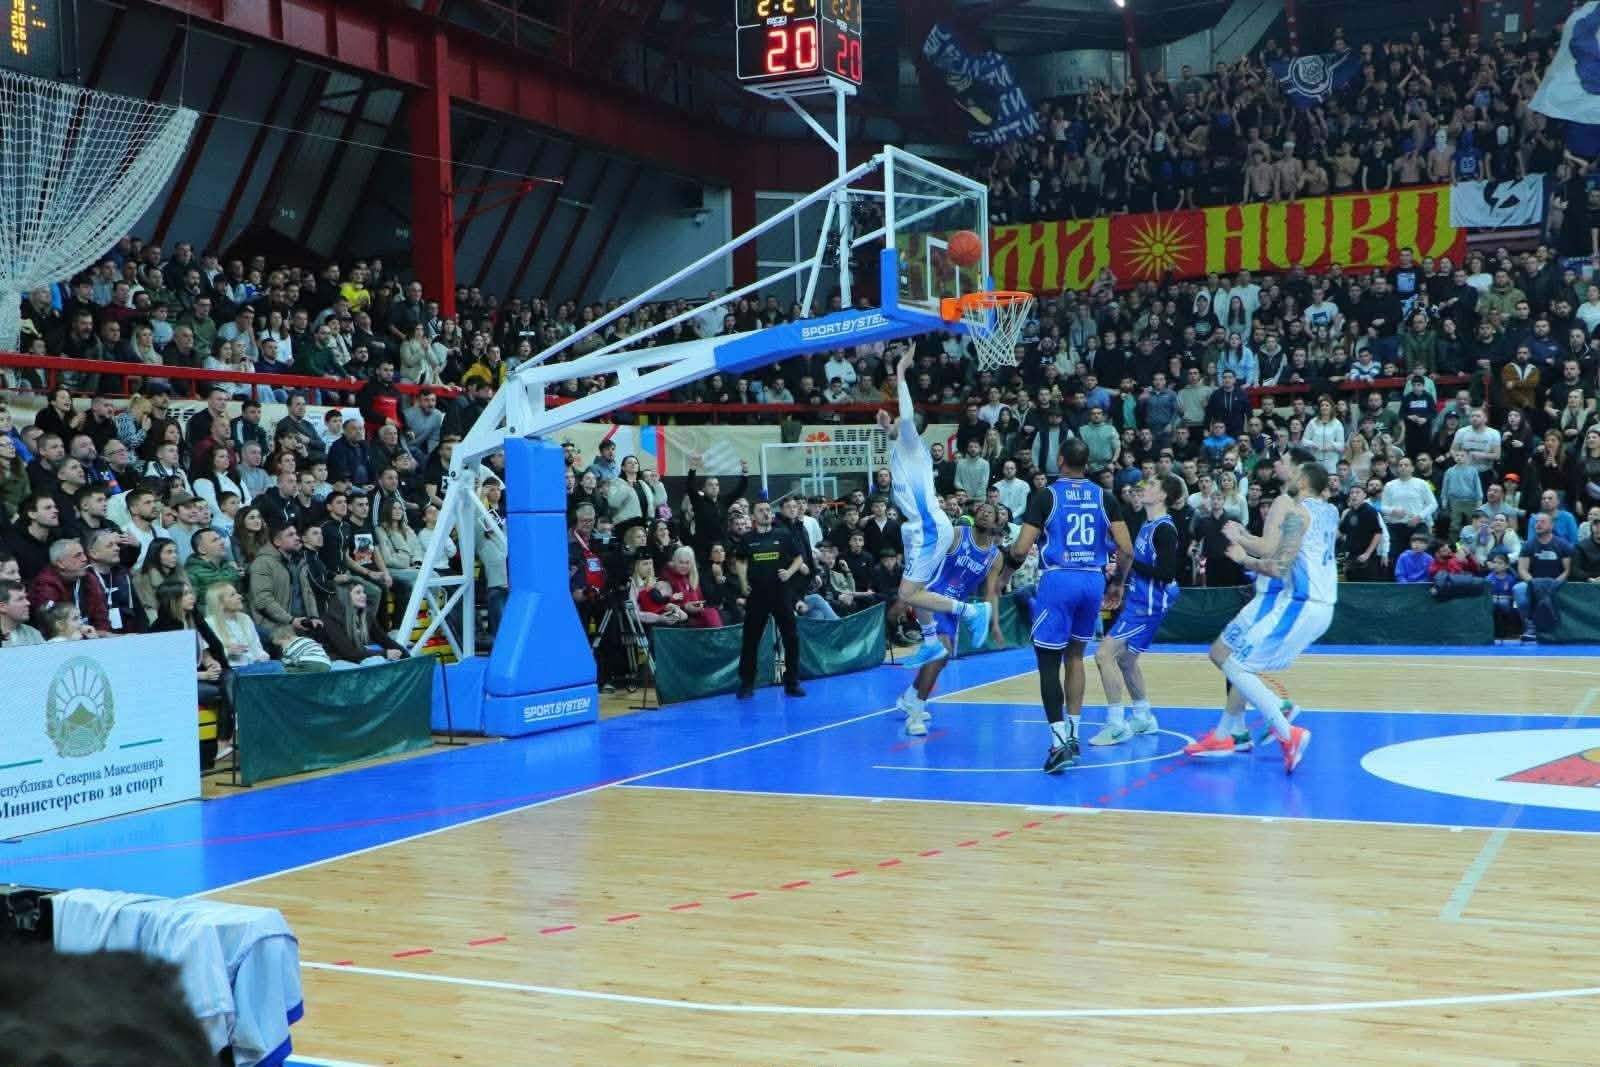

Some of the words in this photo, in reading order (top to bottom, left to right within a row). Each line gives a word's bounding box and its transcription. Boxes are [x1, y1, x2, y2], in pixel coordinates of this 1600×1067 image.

[767, 26, 816, 72] 20
[837, 33, 861, 81] 20
[805, 456, 888, 467] BSKETBLL
[1066, 513, 1095, 546] 26
[523, 697, 591, 719] SPORTSYSTEM
[56, 770, 102, 787] Северна
[104, 757, 164, 777] Македонија
[109, 784, 123, 798] за
[126, 776, 165, 794] спорт
